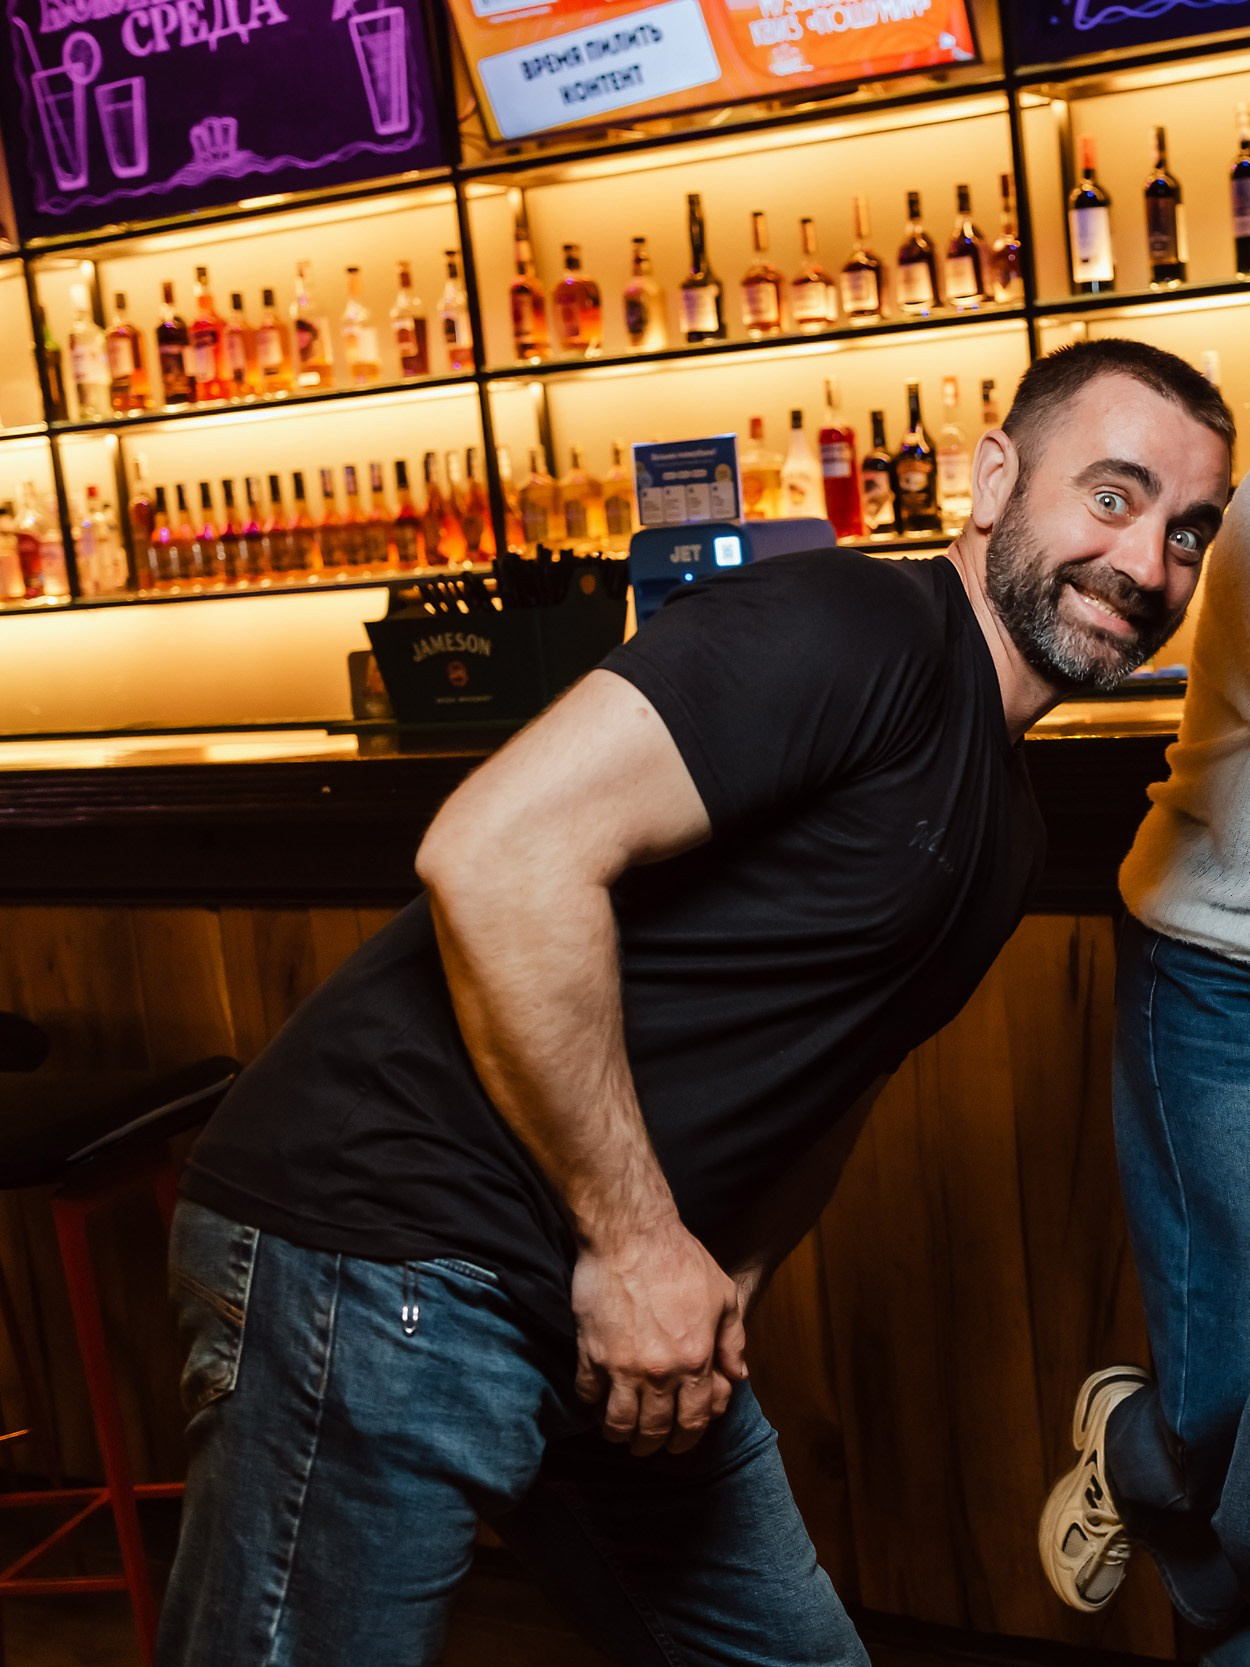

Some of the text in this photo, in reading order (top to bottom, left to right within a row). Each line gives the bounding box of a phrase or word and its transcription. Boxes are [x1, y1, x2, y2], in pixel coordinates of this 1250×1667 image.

[122, 0, 288, 57] СРЕДА
[519, 22, 663, 81] ВРЕМЯ ПИЛИТЬ
[560, 64, 645, 106] КОНТЕНТ
[670, 544, 701, 563] JET
[412, 632, 491, 662] JAMESON
